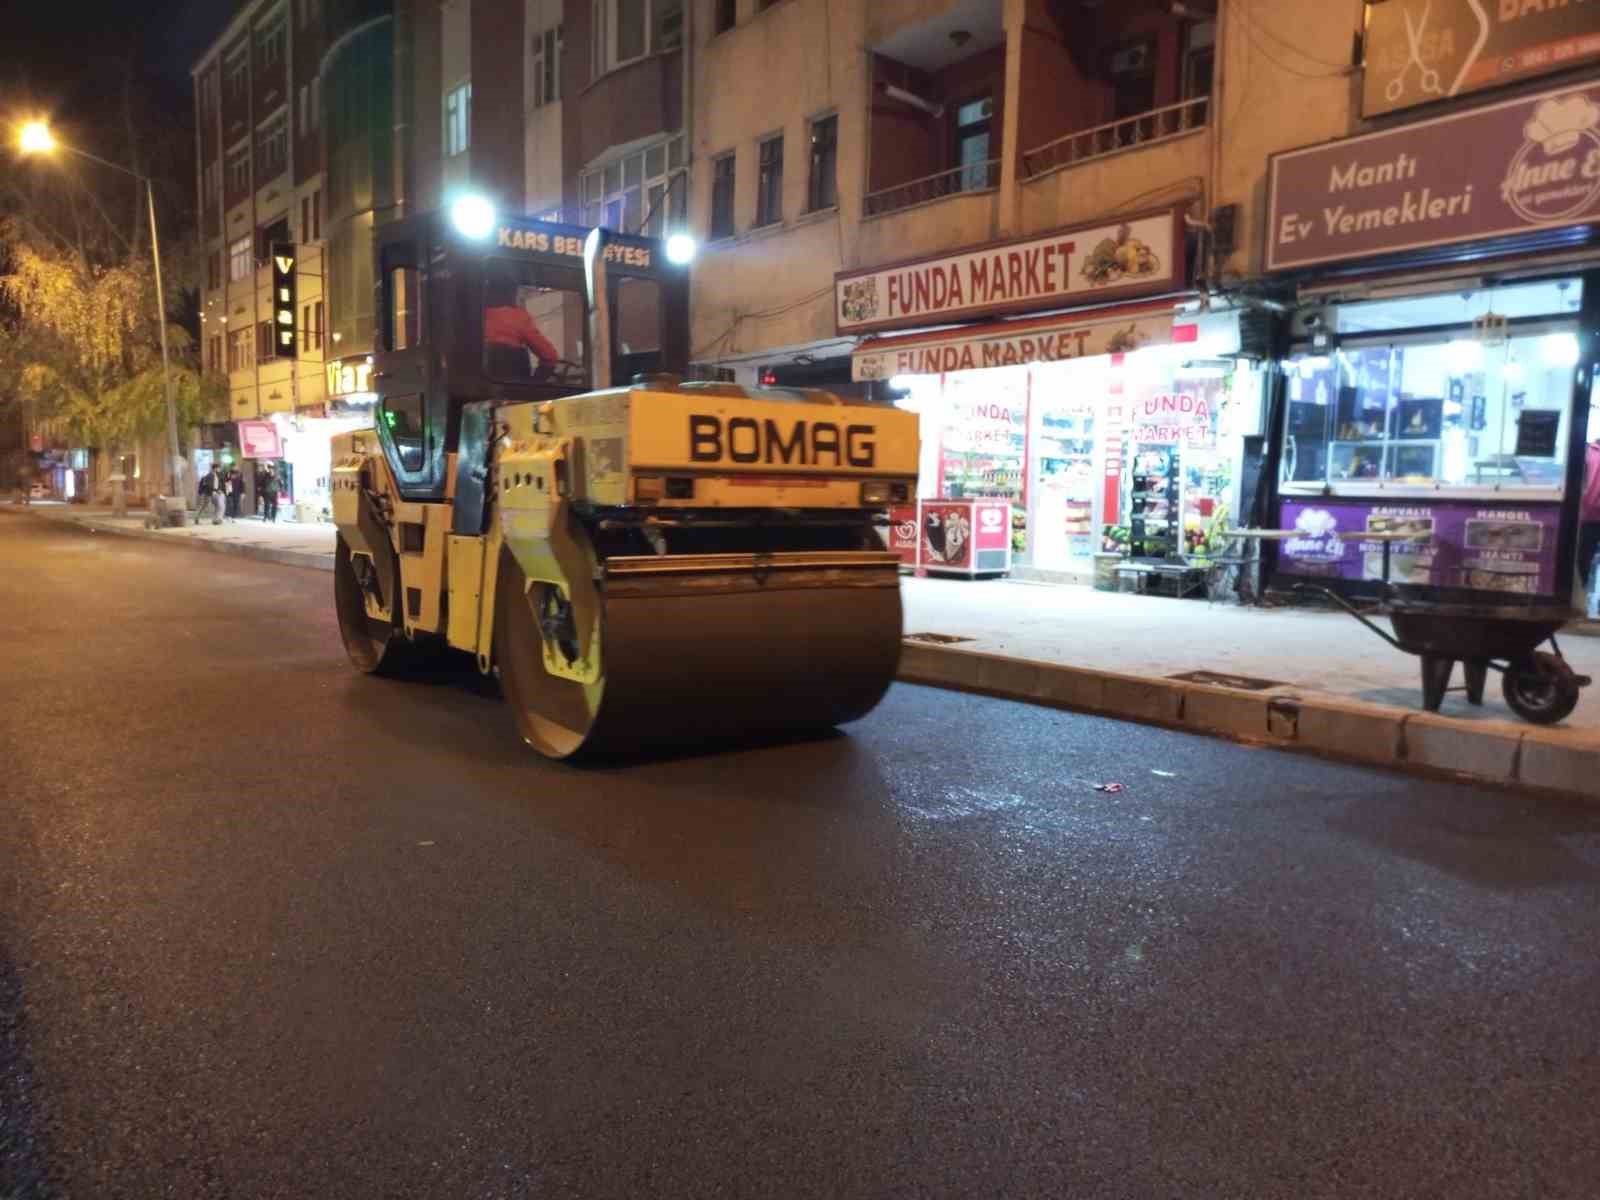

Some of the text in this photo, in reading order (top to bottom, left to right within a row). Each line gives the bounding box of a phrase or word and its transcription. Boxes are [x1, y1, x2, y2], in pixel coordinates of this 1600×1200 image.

[498, 227, 549, 252] KARS
[1279, 214, 1312, 245] Ev
[1322, 184, 1474, 237] Yemekleri
[886, 241, 1076, 317] FUNDA MARKET
[896, 330, 1093, 376] FUNDA MARKET
[689, 414, 876, 468] BOMAG
